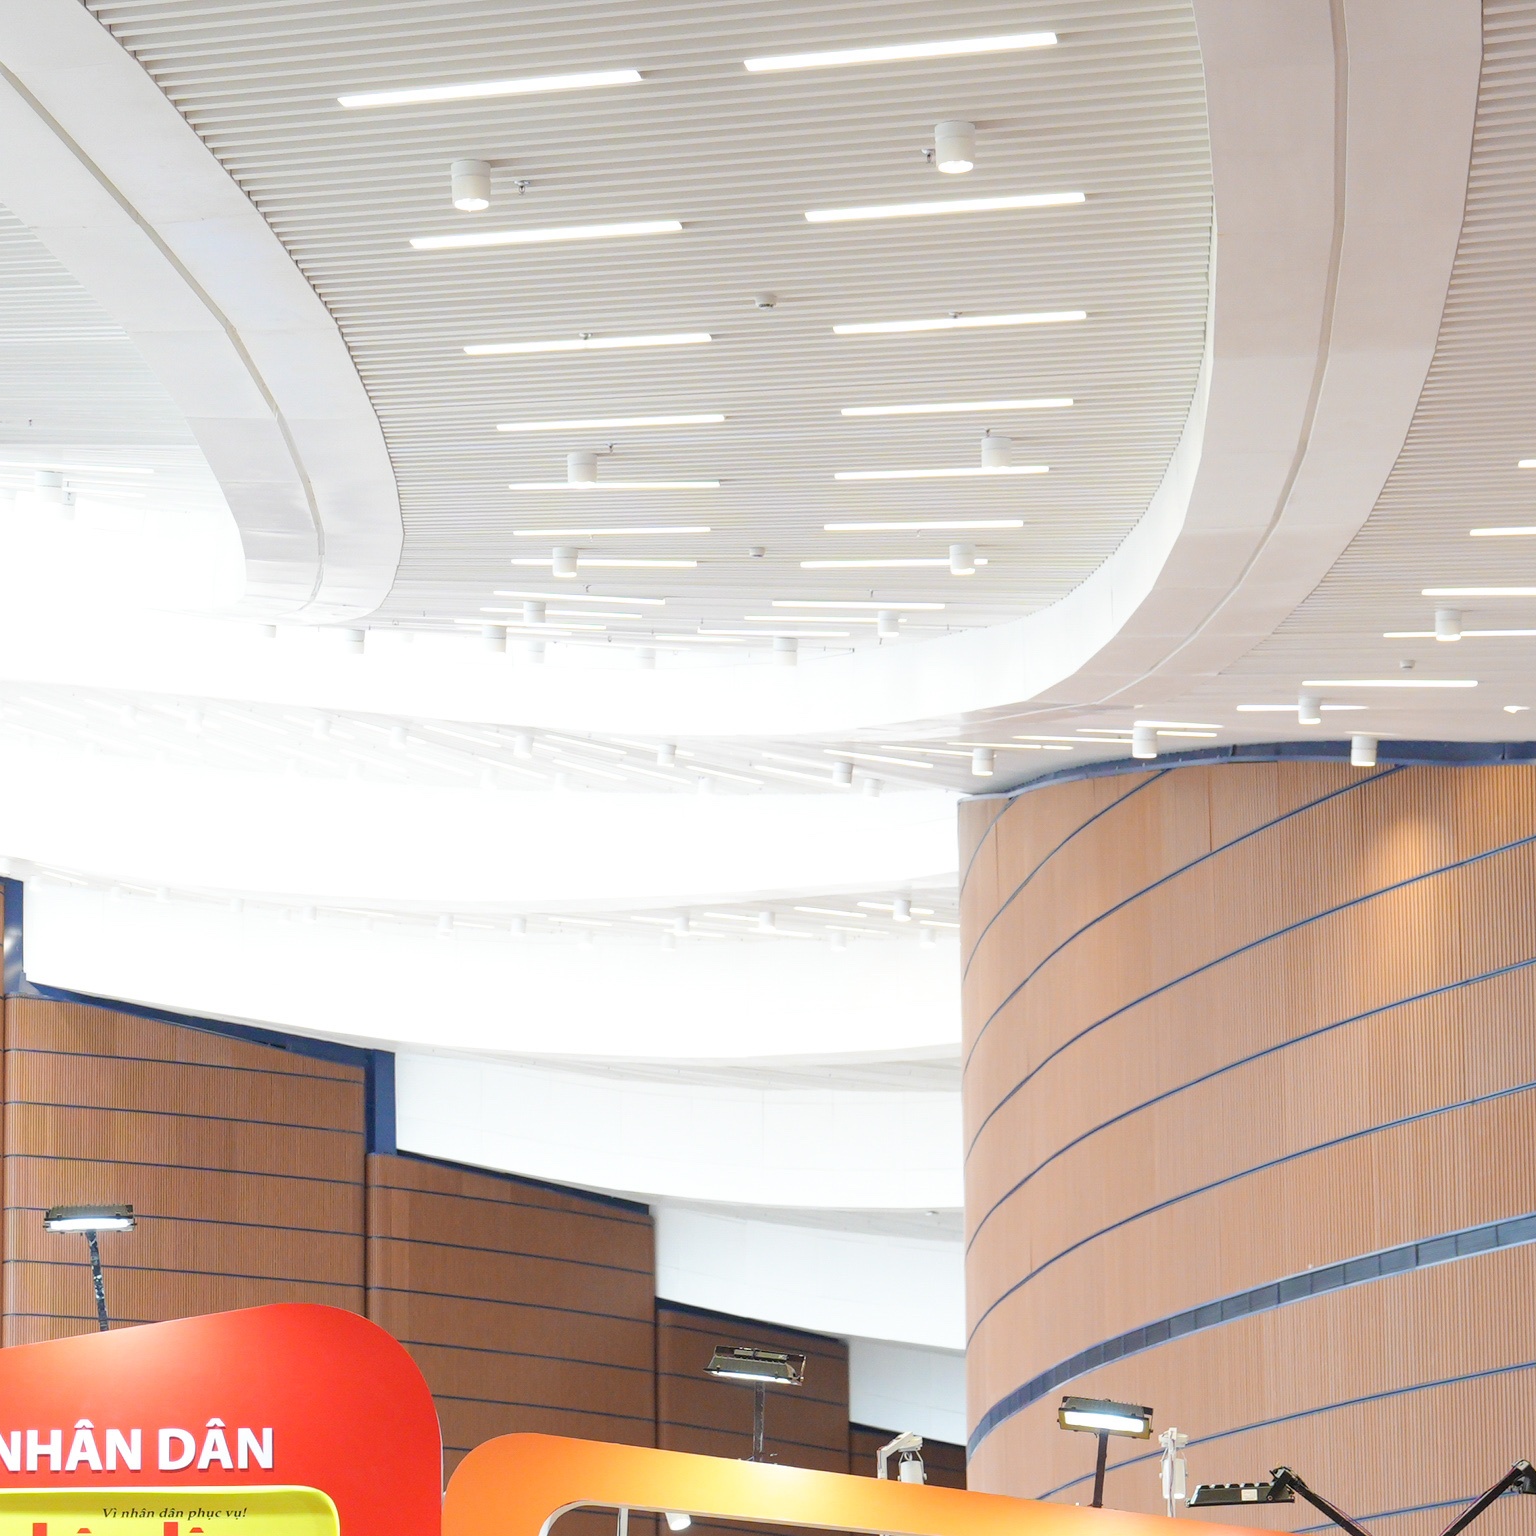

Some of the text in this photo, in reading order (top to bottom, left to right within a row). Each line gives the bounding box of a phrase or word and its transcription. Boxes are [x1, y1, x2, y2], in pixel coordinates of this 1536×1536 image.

[159, 1419, 273, 1470] DÂN
[102, 1507, 247, 1520] Vì nhân dân phục vụ!
